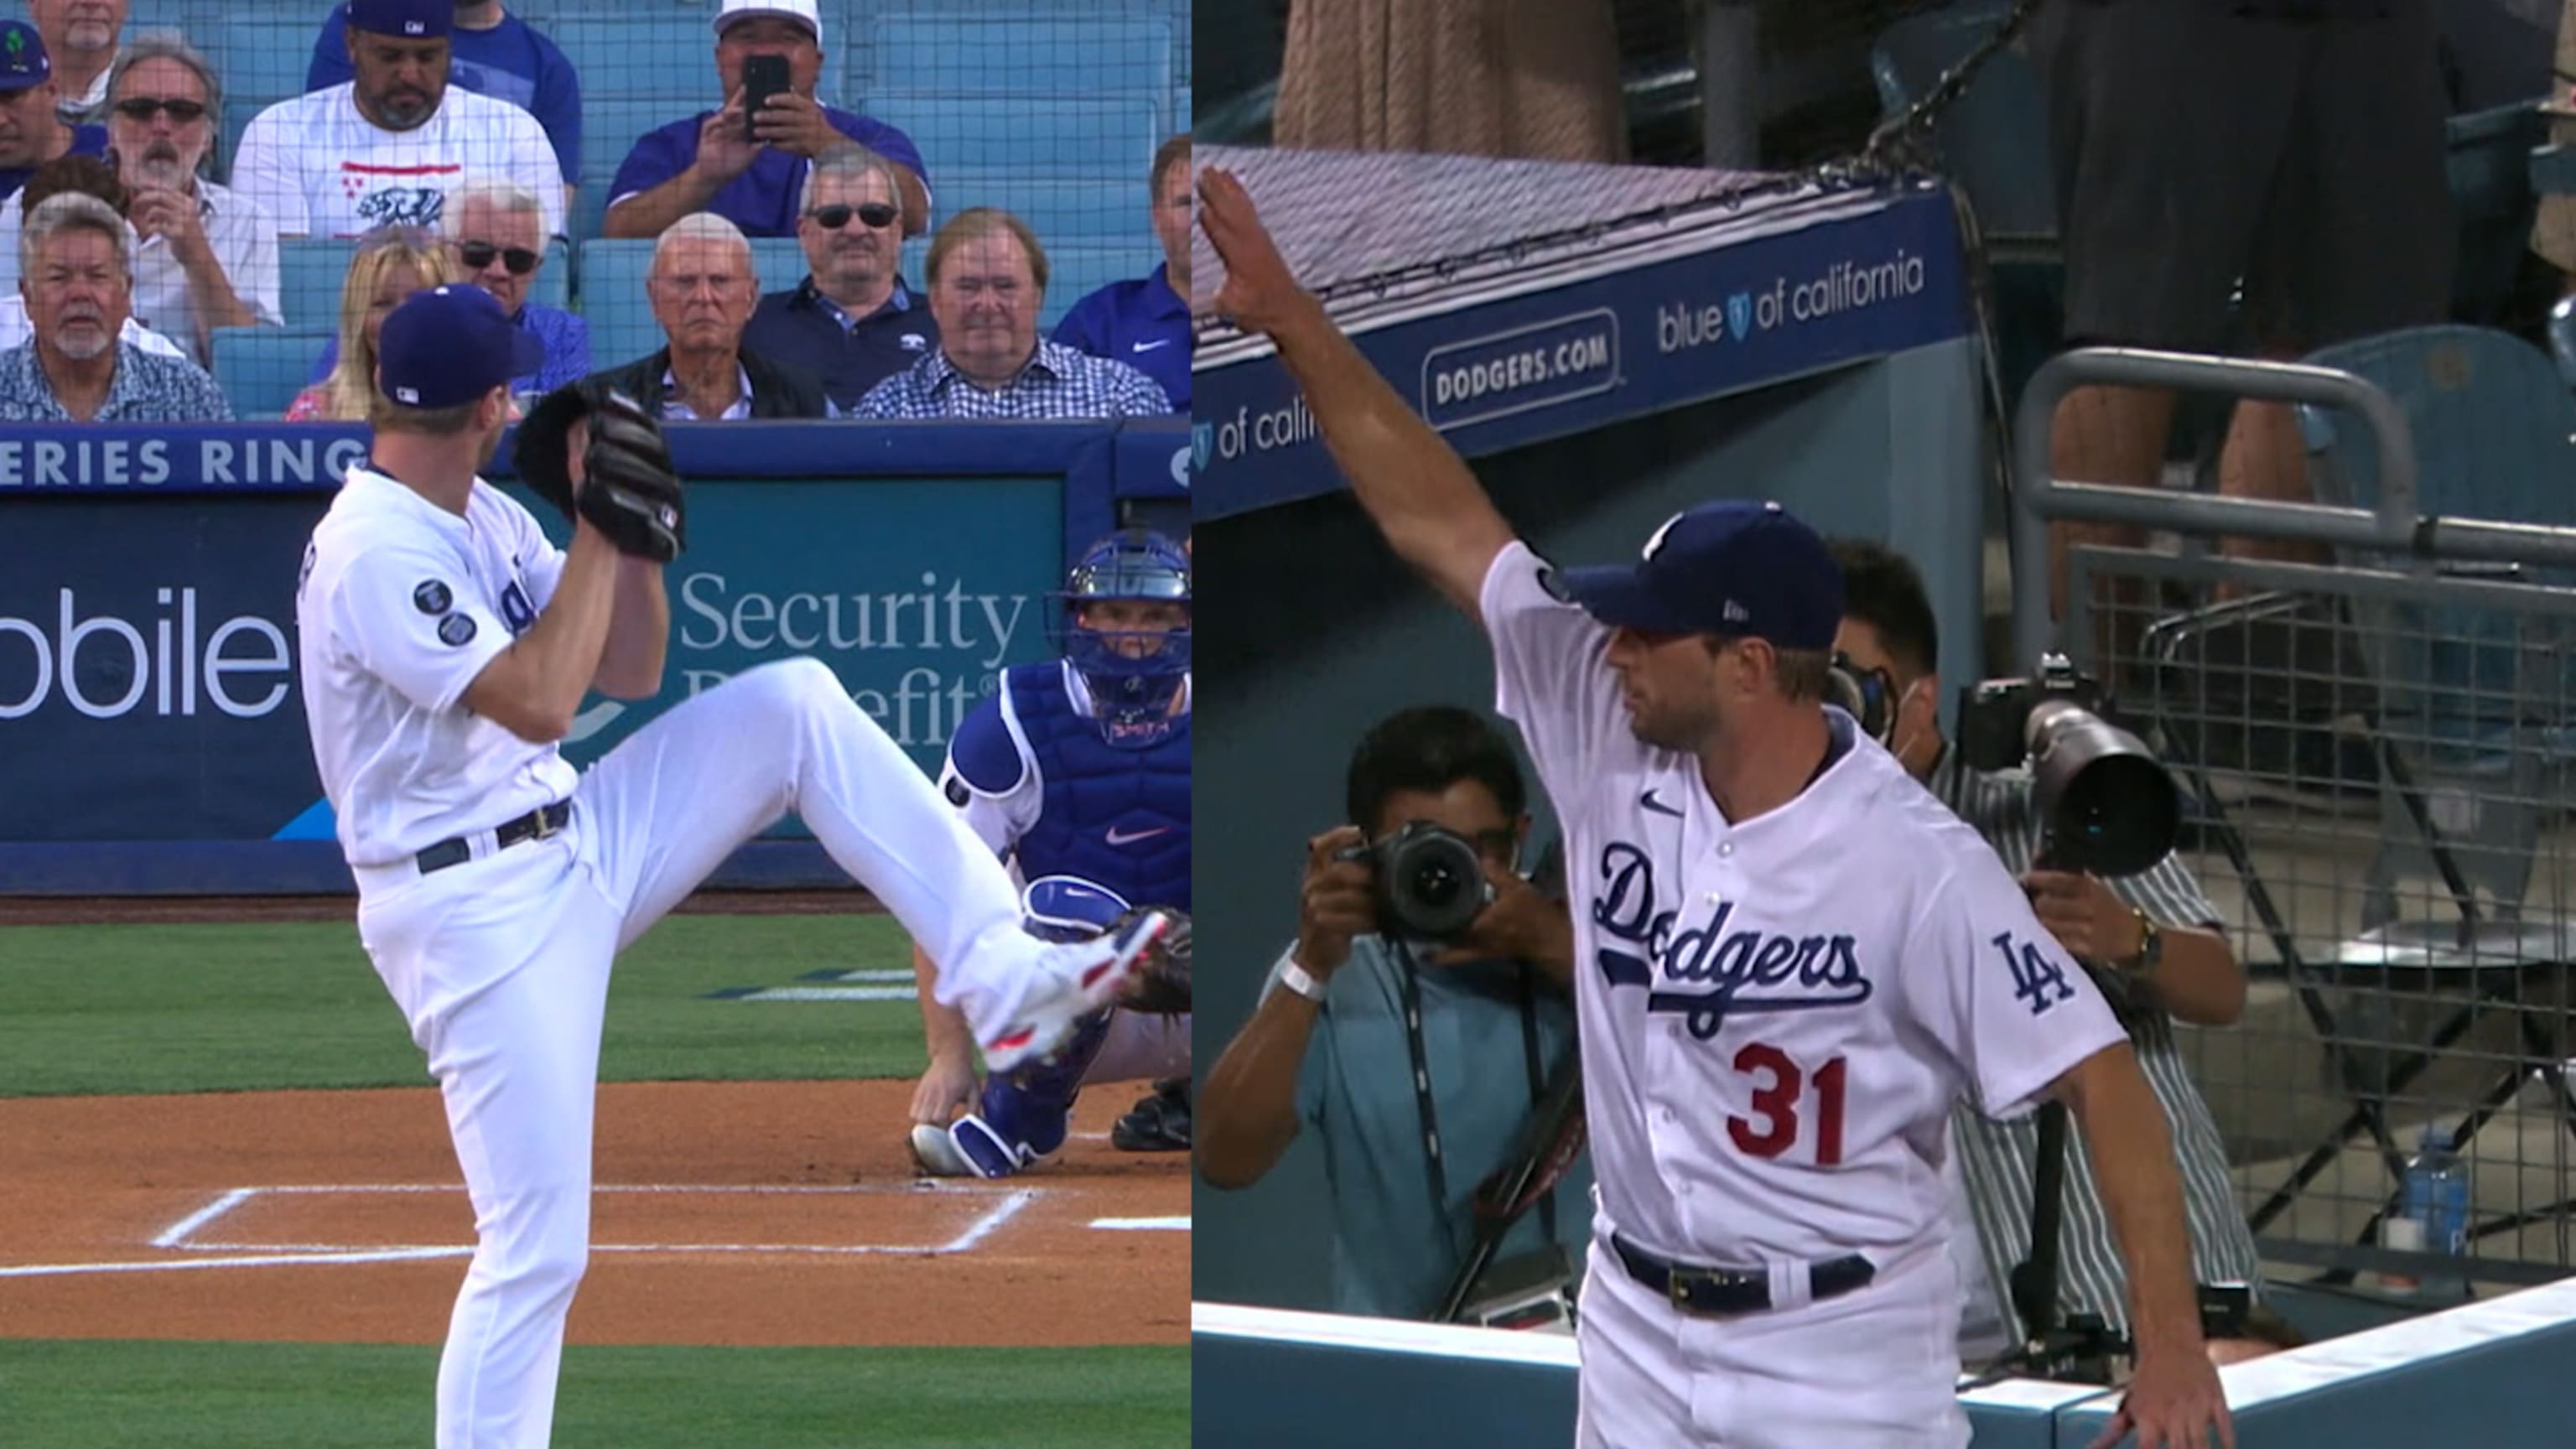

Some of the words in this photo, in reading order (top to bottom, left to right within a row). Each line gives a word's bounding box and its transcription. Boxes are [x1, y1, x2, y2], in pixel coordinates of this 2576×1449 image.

[1658, 304, 1723, 352] blue
[1757, 278, 1786, 329] of
[1793, 249, 1924, 321] california
[1436, 334, 1608, 405] DODGERS.COM
[1219, 406, 1248, 459] of
[681, 572, 1027, 668] Security
[1594, 843, 1872, 1040] Dodgers
[1992, 930, 2076, 1017] LA
[1727, 1041, 1847, 1166] 31
